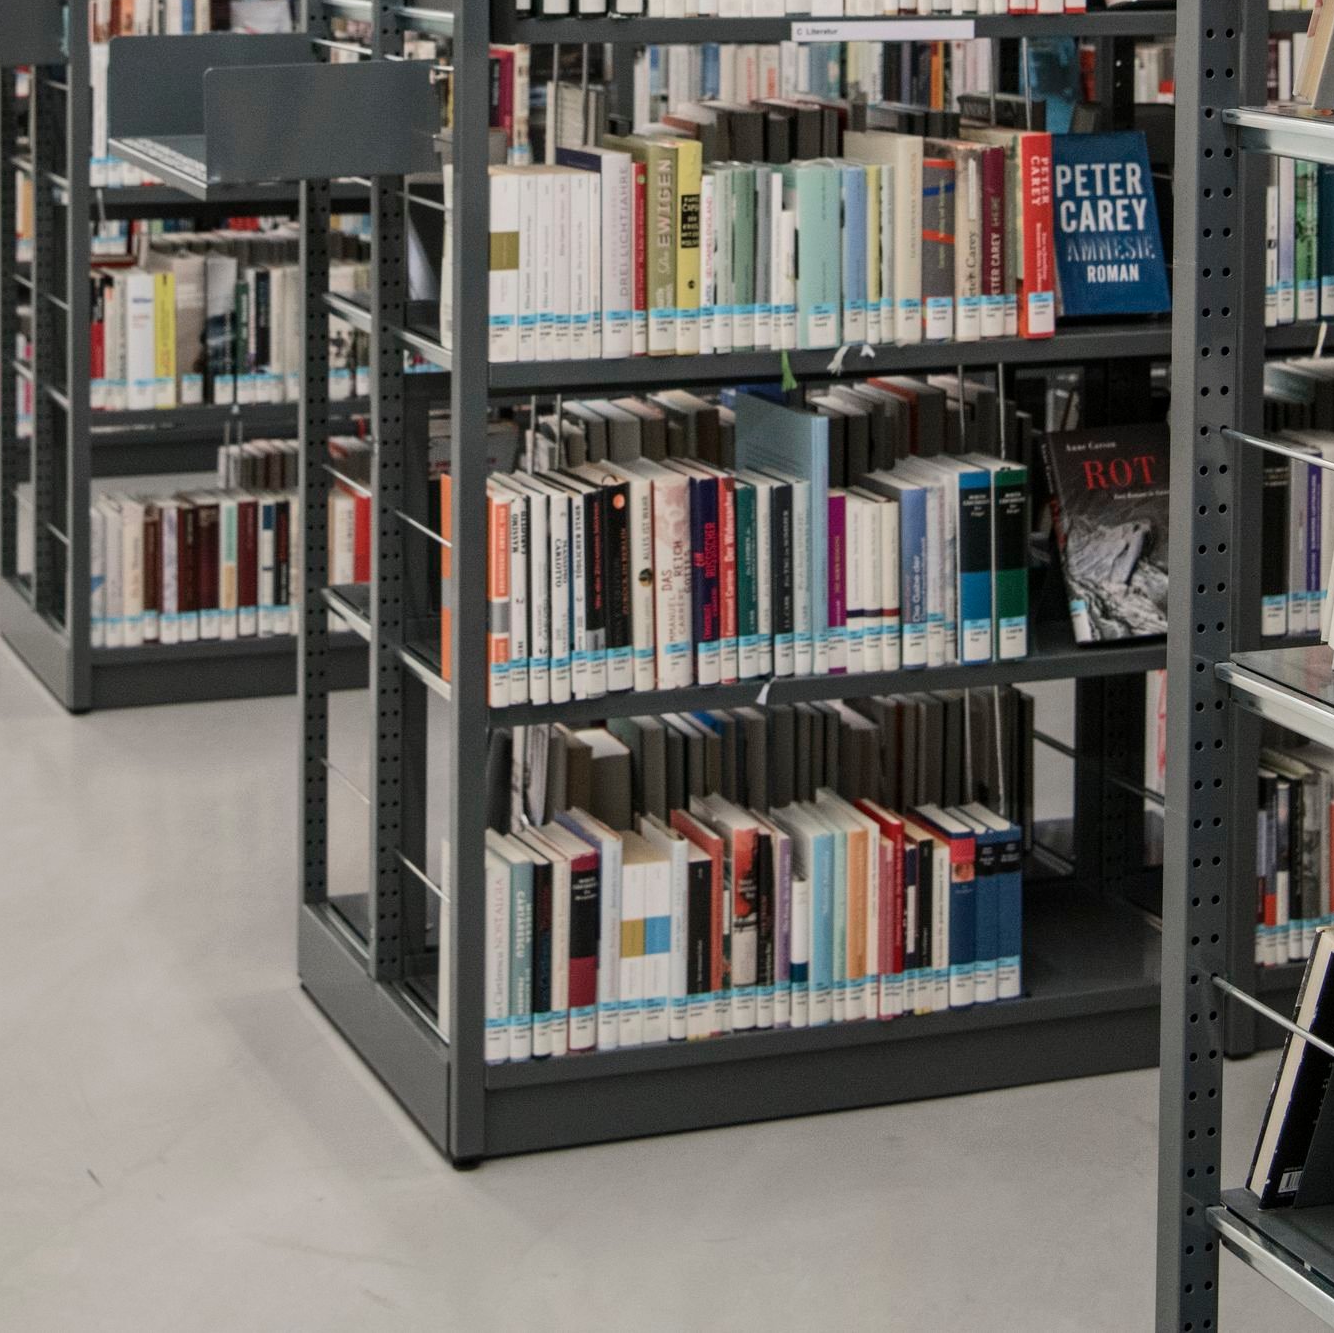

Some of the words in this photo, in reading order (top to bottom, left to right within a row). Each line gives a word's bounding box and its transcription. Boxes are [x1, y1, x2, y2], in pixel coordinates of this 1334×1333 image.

[806, 27, 838, 36] Literatur
[1030, 155, 1041, 206] CAREY
[1040, 156, 1050, 204] PETER
[1056, 163, 1144, 197] PETER
[619, 167, 630, 263] LICHTJAHRE
[657, 158, 672, 248] EWIGEN
[1060, 198, 1147, 233] CAREY
[990, 232, 1001, 265] CAREY
[1067, 233, 1156, 262] AMNESIE
[619, 267, 629, 298] DREI
[1087, 264, 1140, 283] ROMAN
[1066, 441, 1087, 452] Anne
[1082, 455, 1156, 491] ROT
[662, 569, 672, 592] DAS
[673, 541, 684, 578] REICH
[704, 522, 716, 579] RUSSISCHER
